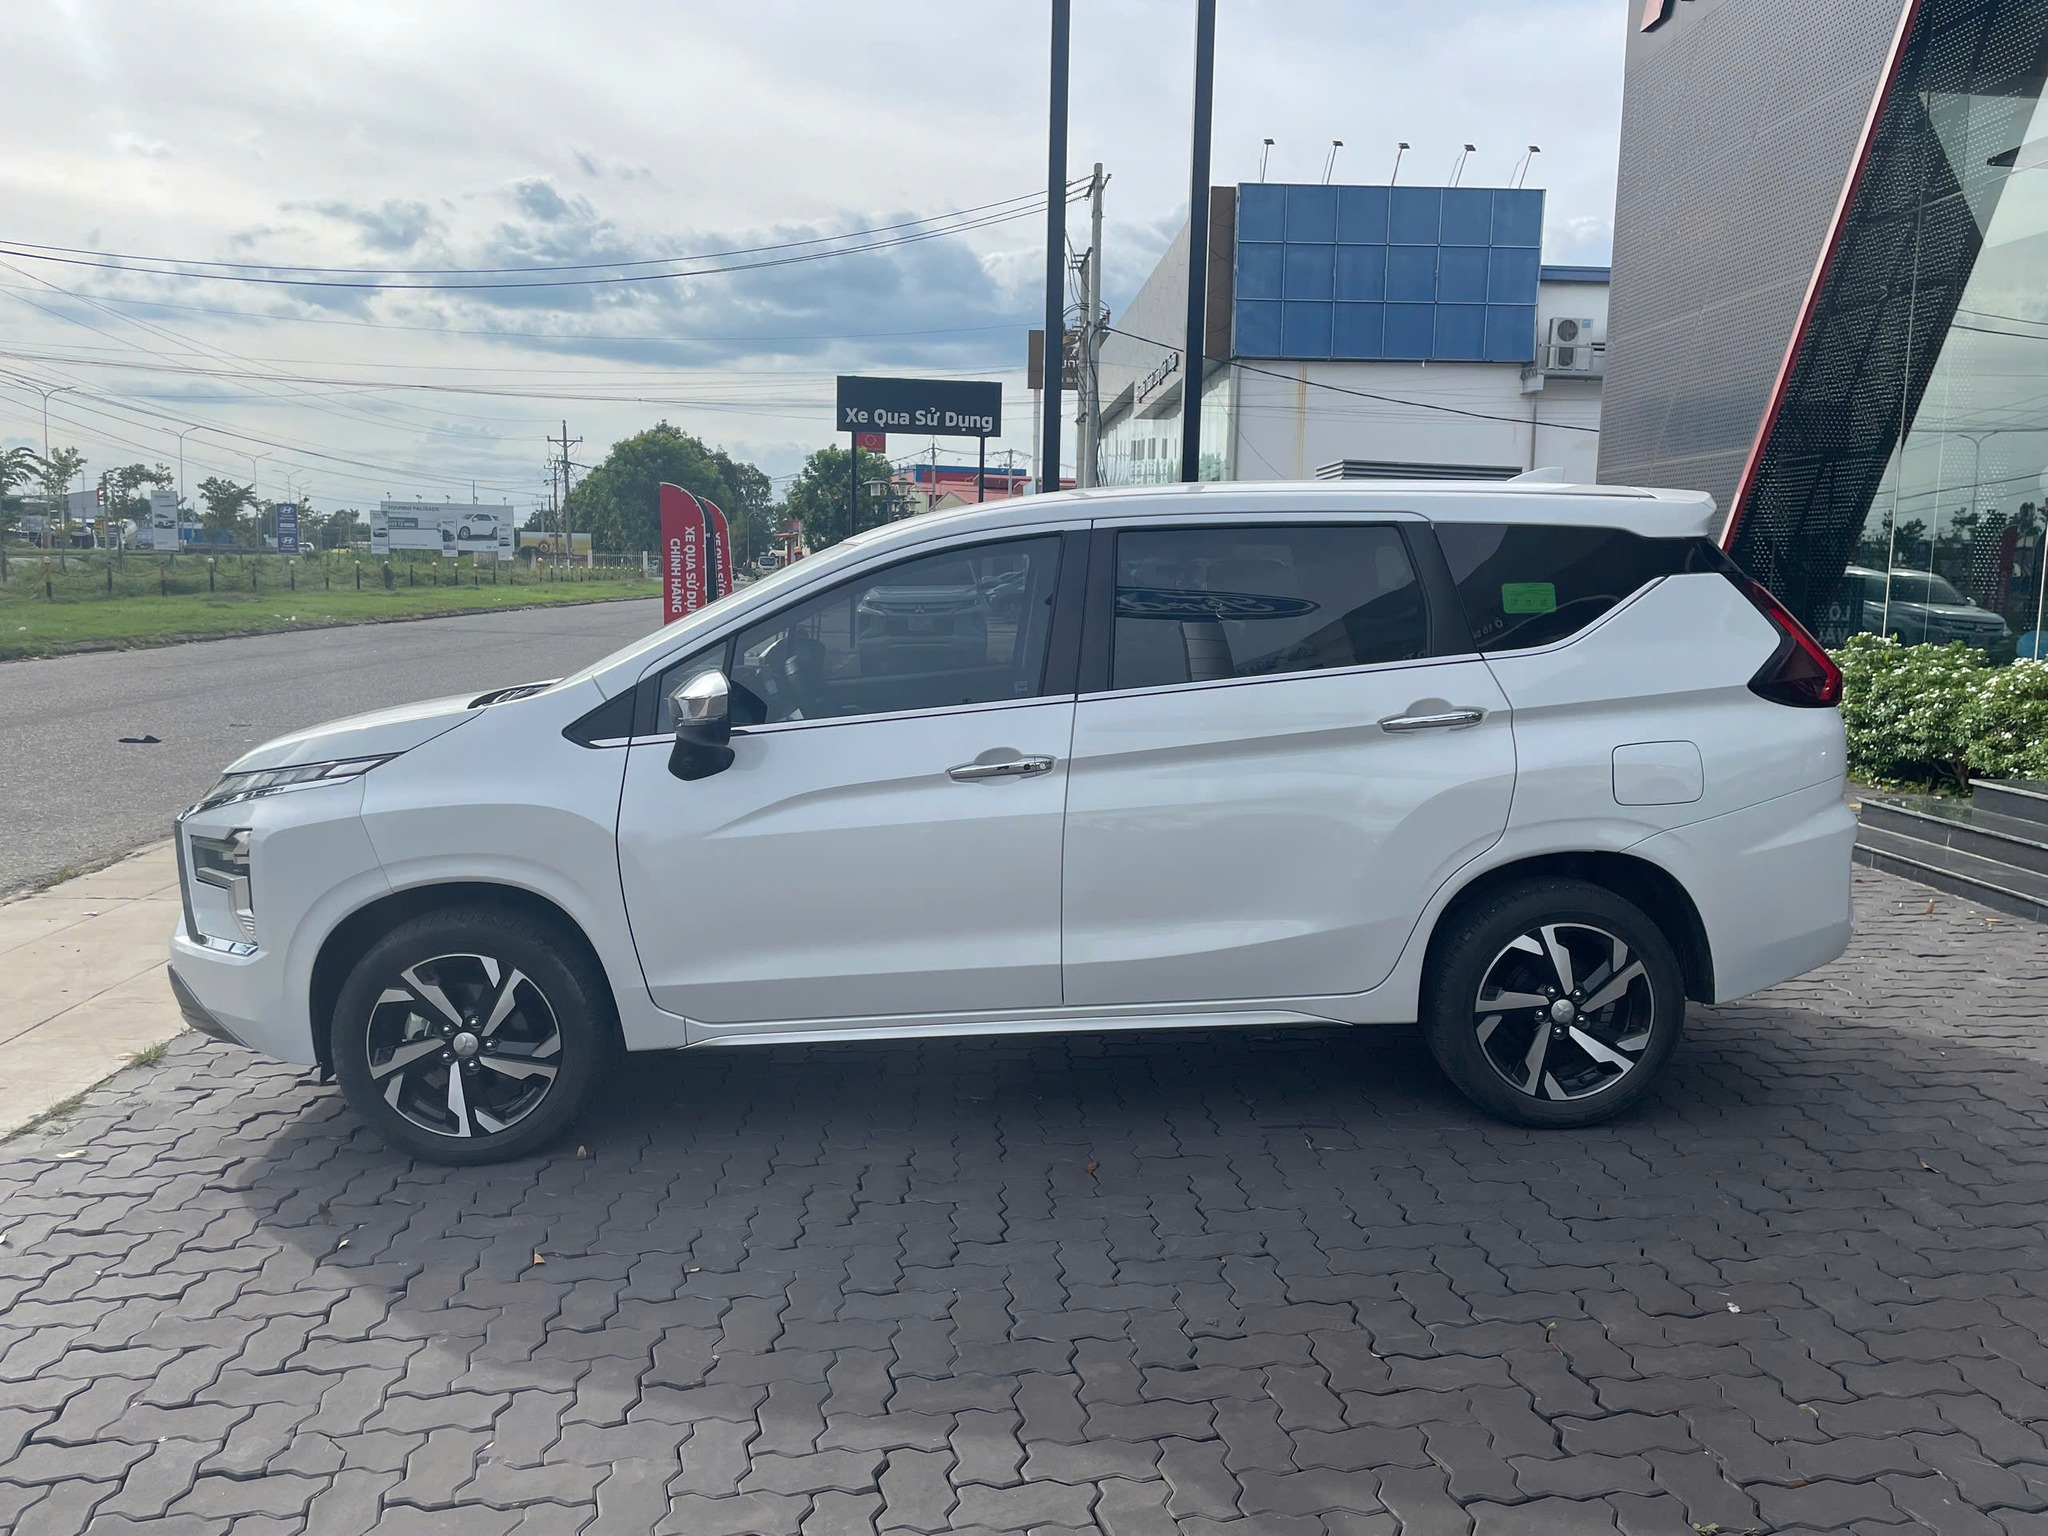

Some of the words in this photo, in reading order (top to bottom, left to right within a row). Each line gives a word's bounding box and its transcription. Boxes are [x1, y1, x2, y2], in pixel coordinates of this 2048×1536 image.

[845, 407, 868, 423] Xe
[874, 409, 909, 427] Qua
[915, 407, 940, 426] Sử
[945, 411, 993, 432] Dụng
[685, 526, 696, 542] XE
[670, 538, 684, 576] CHÍNH
[683, 544, 696, 571] QUA
[686, 572, 700, 590] SỬ
[671, 578, 685, 613] HÃNG
